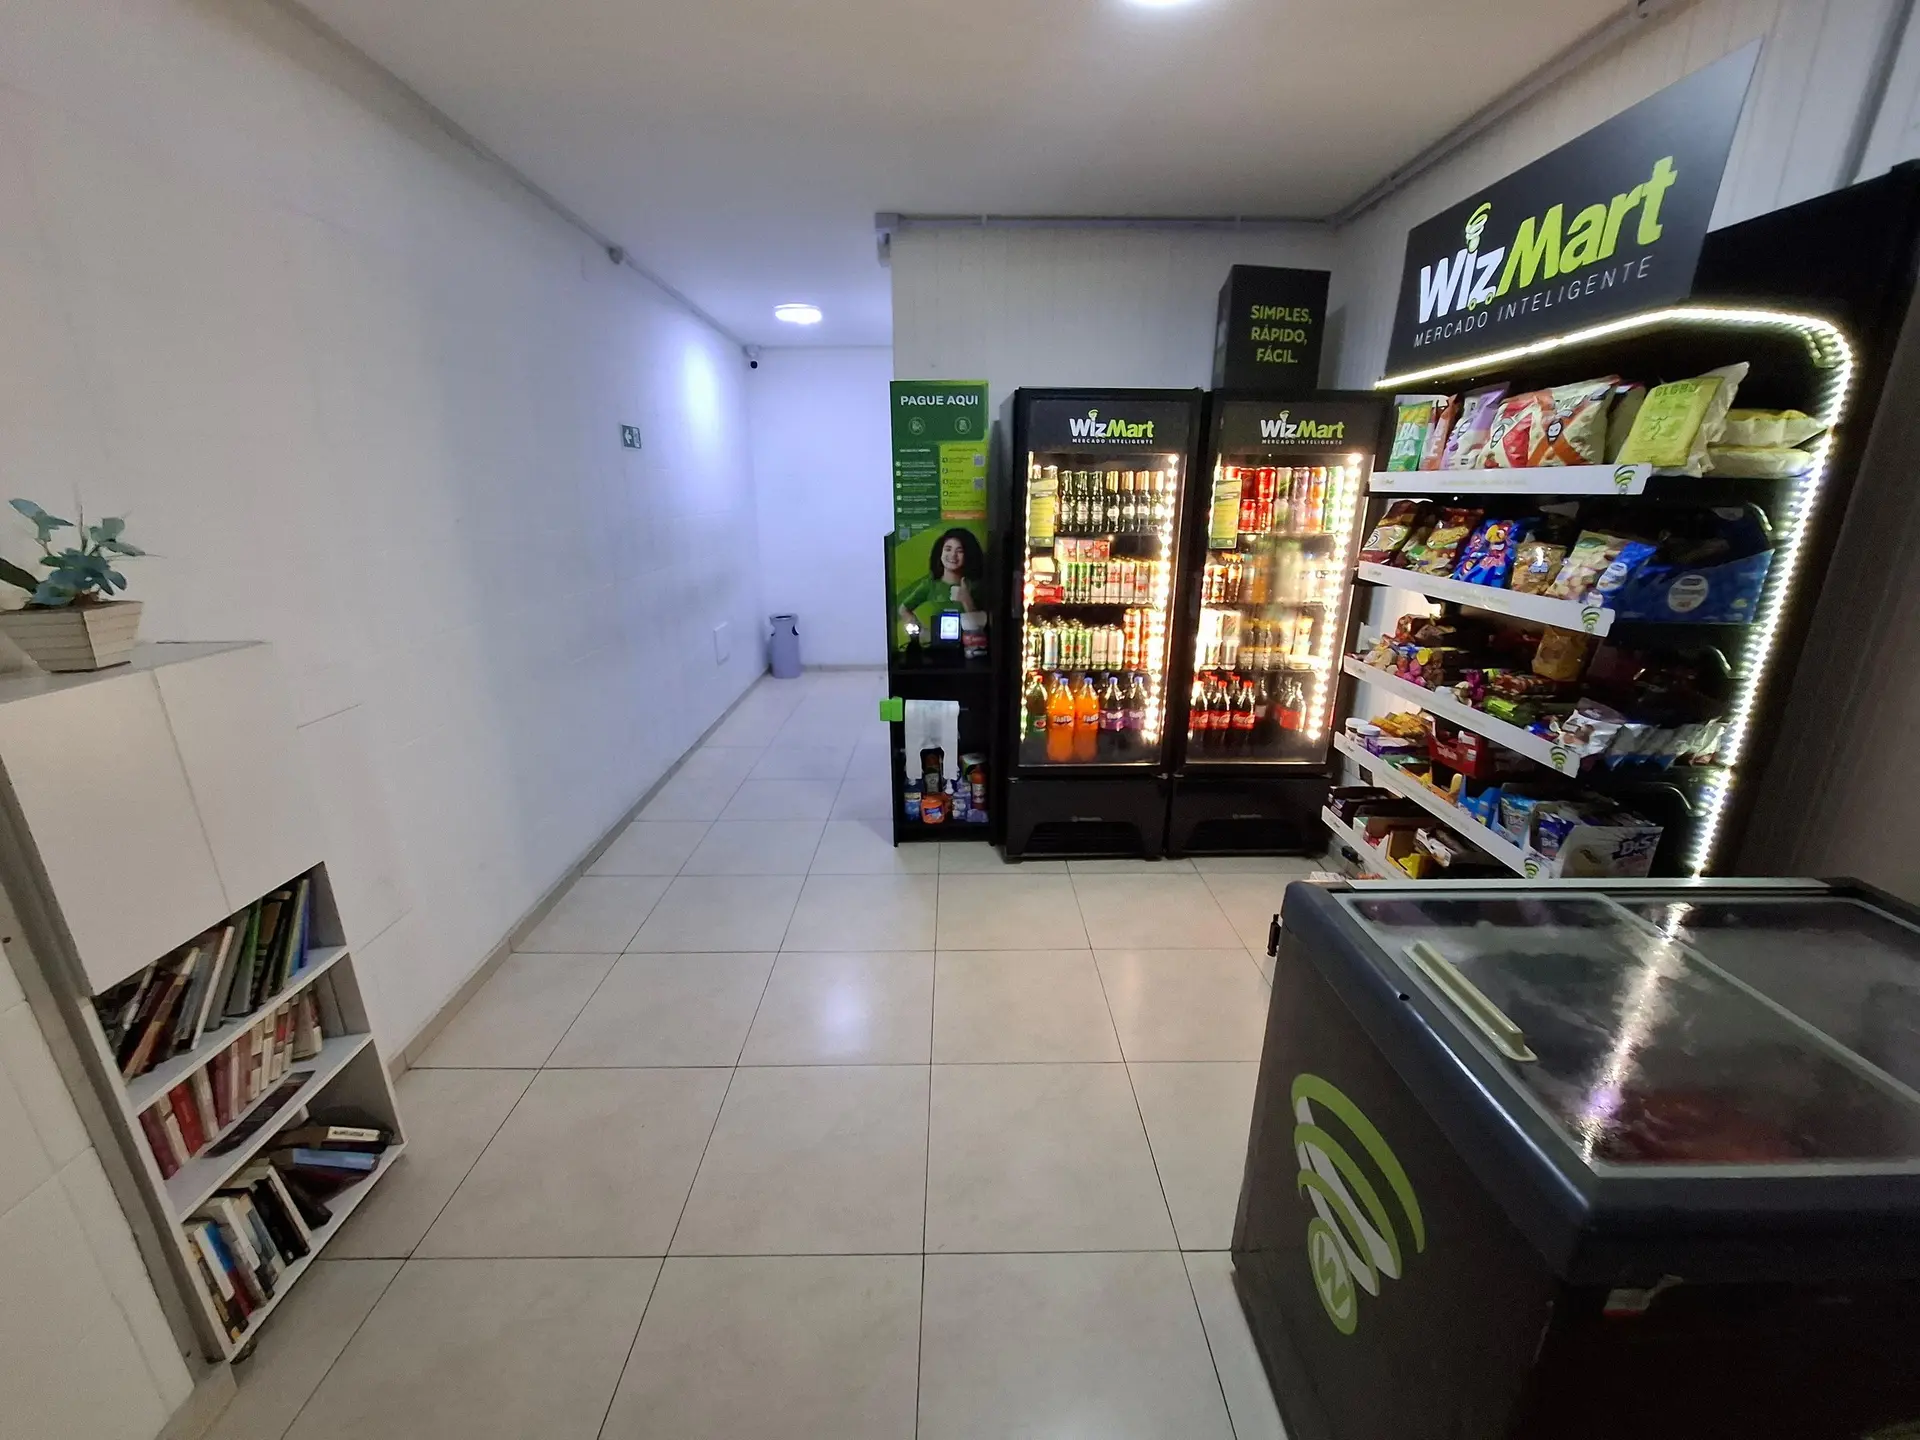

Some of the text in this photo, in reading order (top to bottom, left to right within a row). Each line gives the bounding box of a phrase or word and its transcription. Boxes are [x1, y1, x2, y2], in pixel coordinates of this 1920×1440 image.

[1418, 155, 1678, 324] WizMart
[1413, 255, 1654, 348] MERCADO INTELIGENTE
[1250, 305, 1312, 324] SIMPLES,
[1251, 324, 1307, 346] RÁPIDO,
[1256, 345, 1298, 363] FÁCIL.
[900, 395, 979, 407] PAGUE AQUI
[1069, 418, 1154, 438] WizMart
[1260, 419, 1345, 439] WizMart
